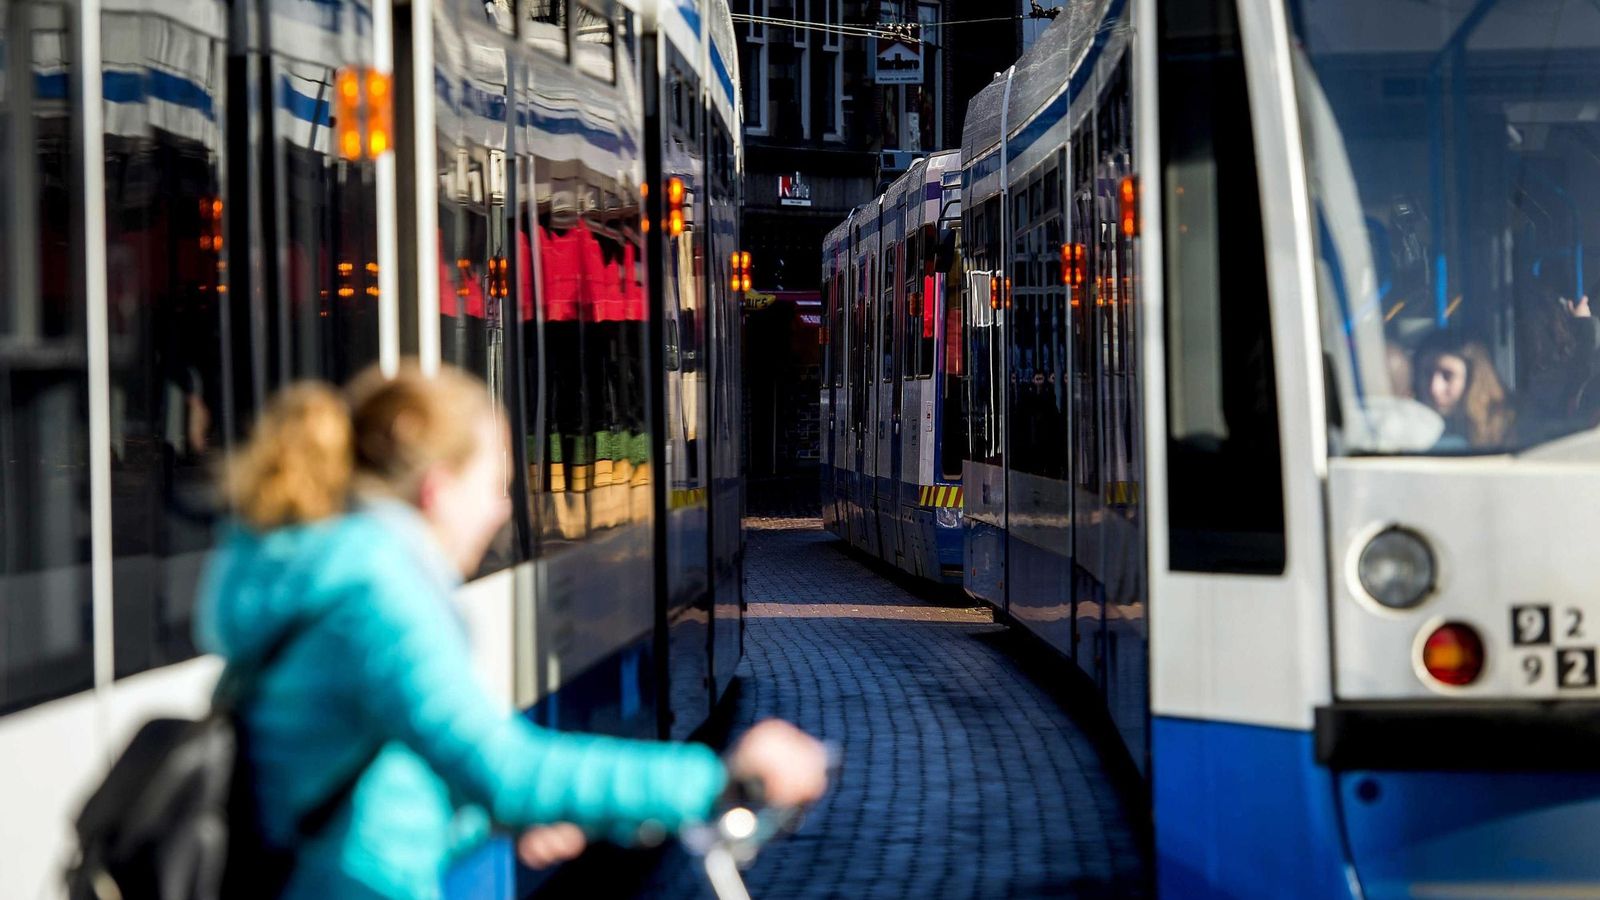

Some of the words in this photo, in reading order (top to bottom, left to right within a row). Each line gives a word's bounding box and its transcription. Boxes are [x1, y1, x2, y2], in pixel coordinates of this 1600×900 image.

[1517, 608, 1545, 643] 9
[1565, 606, 1585, 638] 2
[1522, 654, 1543, 685] 9
[1562, 651, 1590, 685] 2
